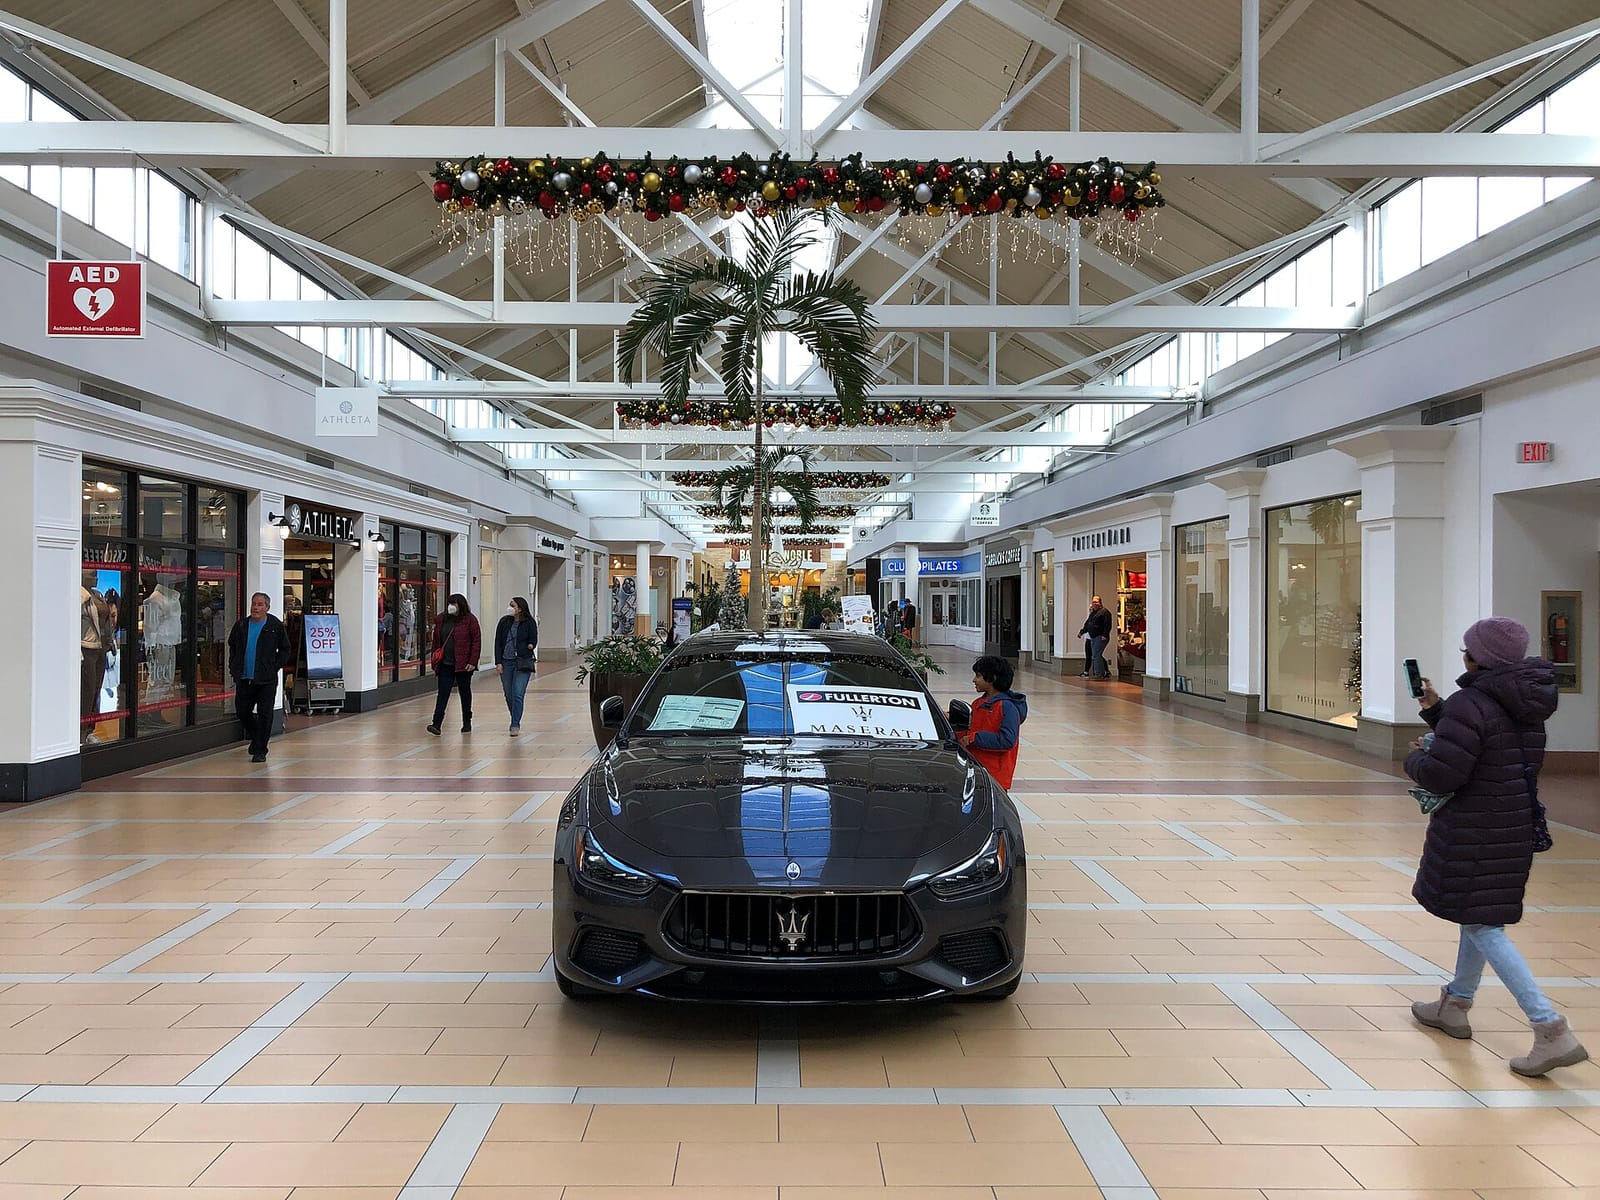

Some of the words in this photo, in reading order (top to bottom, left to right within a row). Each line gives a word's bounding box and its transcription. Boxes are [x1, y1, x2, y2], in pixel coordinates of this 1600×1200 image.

[68, 266, 120, 283] AED
[321, 415, 371, 424] ATHLETA
[1523, 442, 1547, 461] EXIT
[302, 511, 354, 541] ATHLETA
[784, 549, 813, 561] NOBLE
[887, 562, 905, 572] CLU
[922, 560, 958, 572] PILATES
[310, 626, 336, 638] 25%
[311, 638, 336, 649] OFF
[825, 692, 917, 708] FULLERTON
[810, 723, 924, 741] MASERATI
